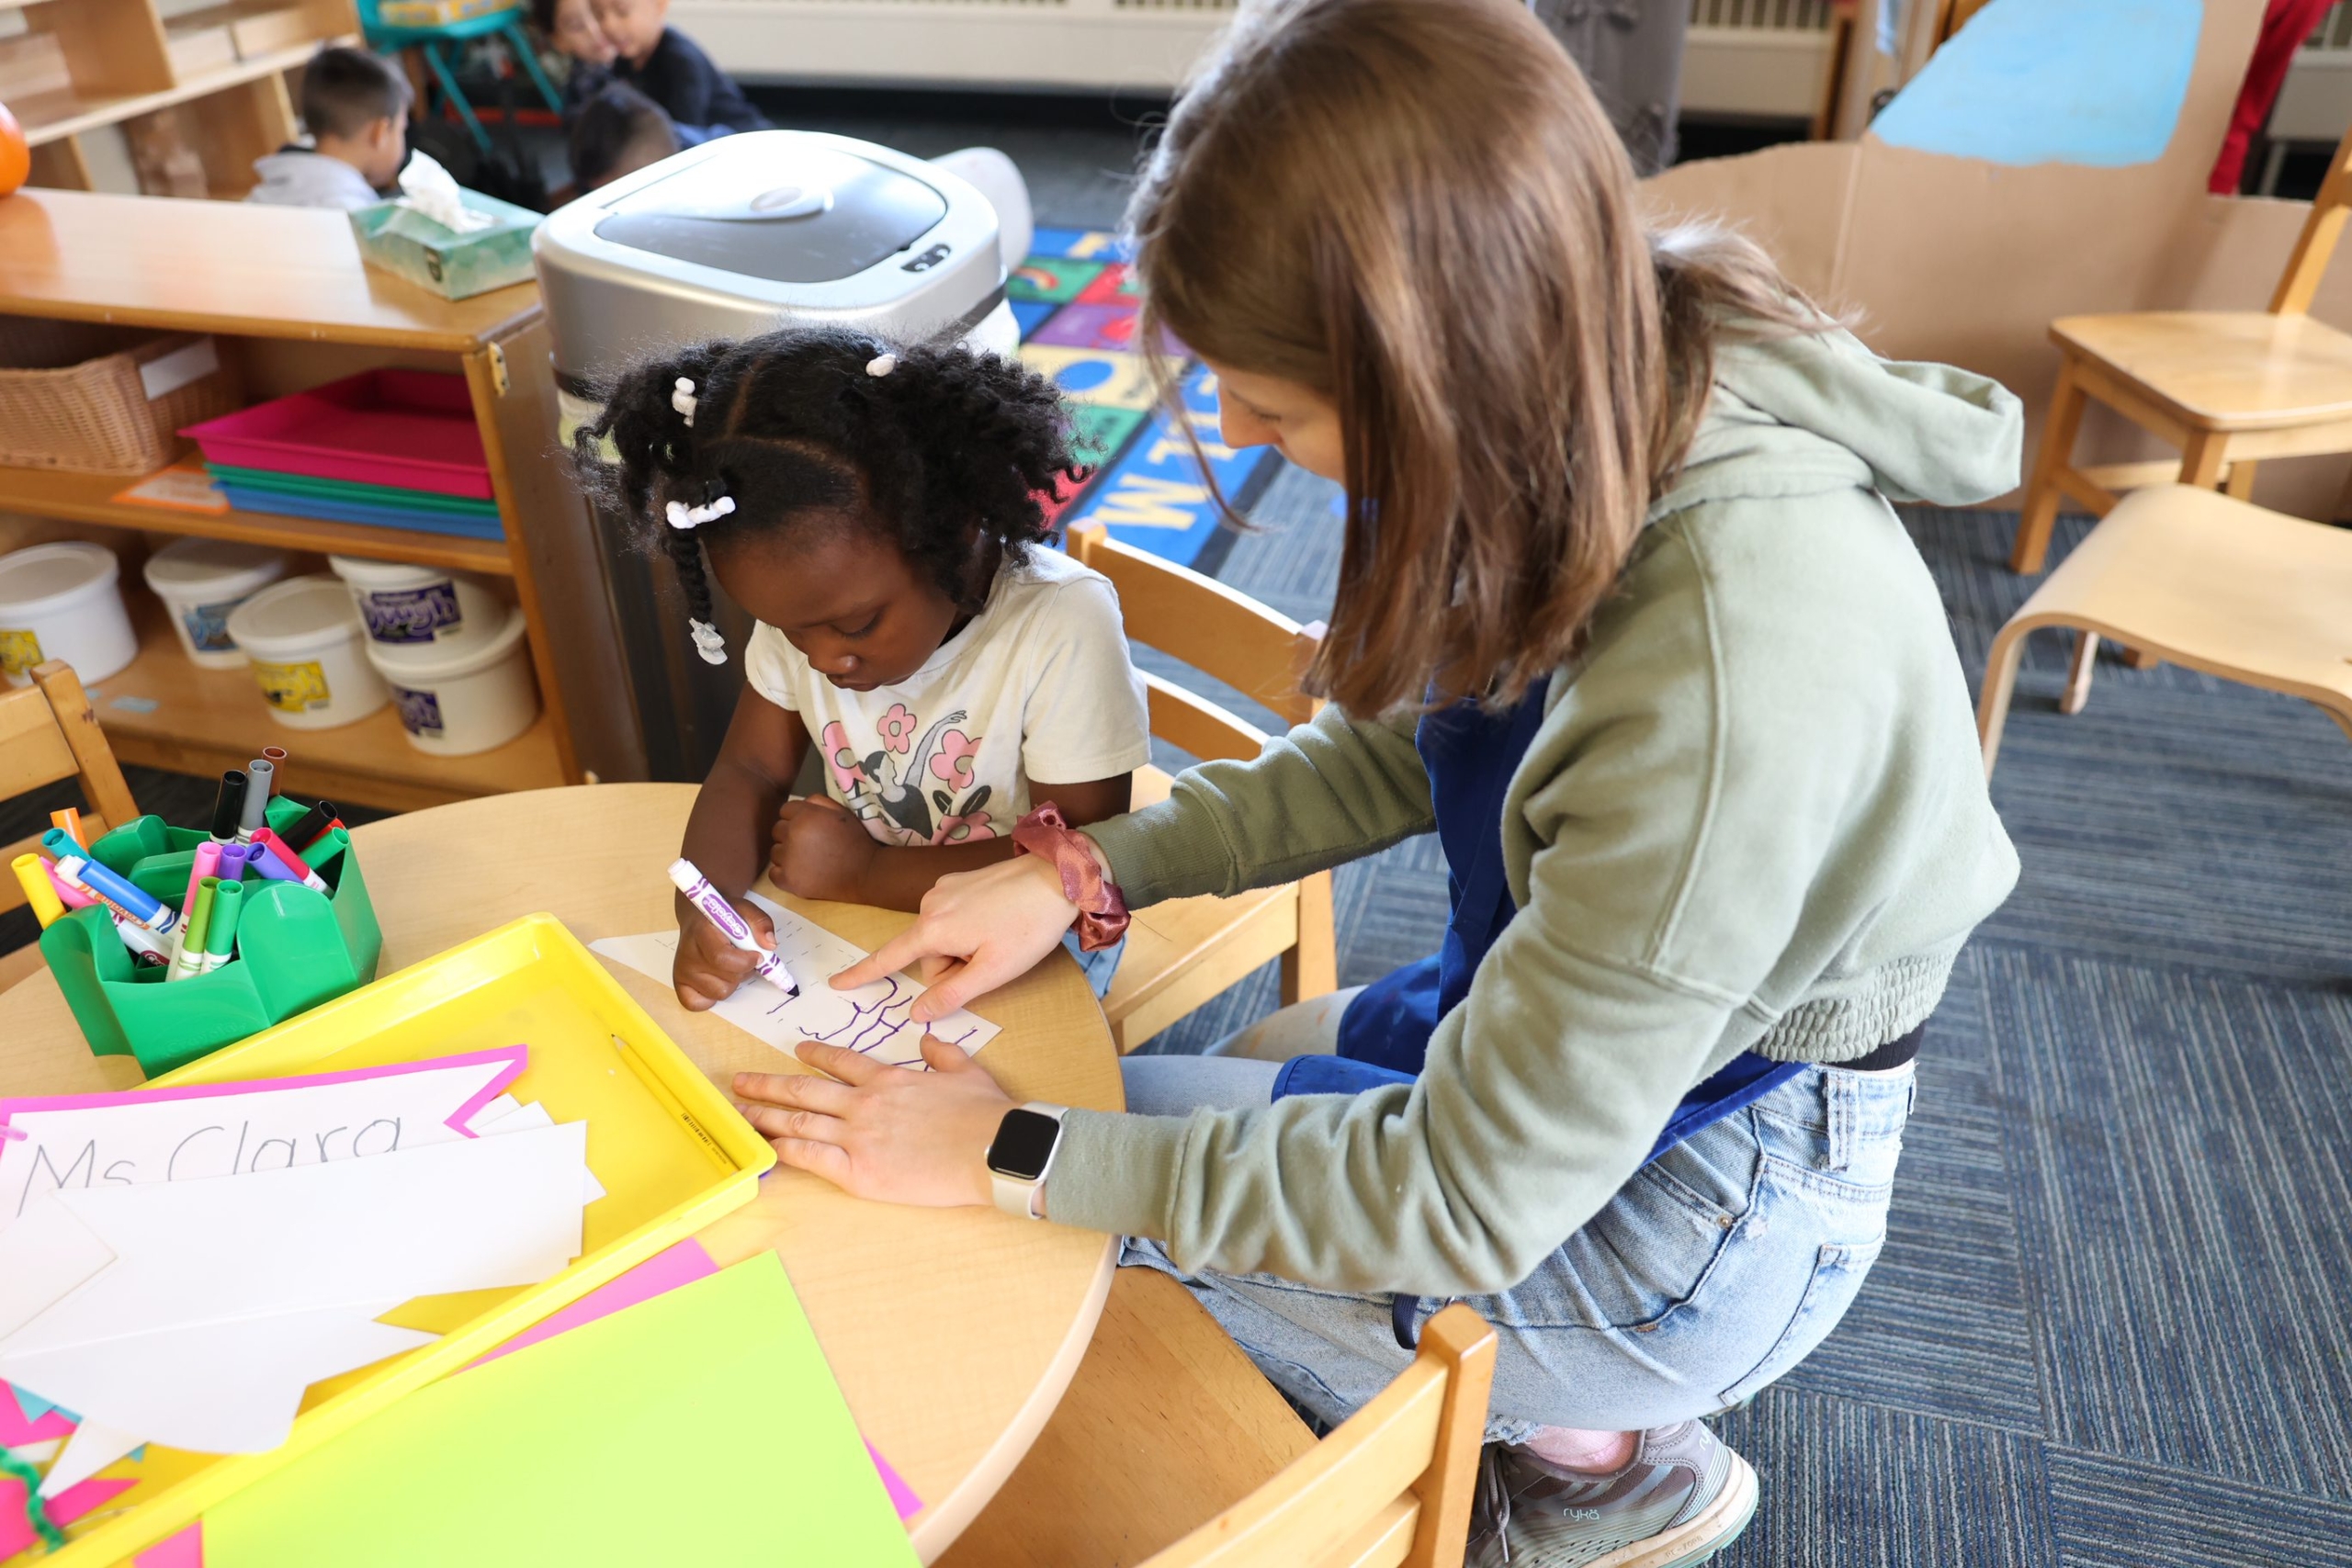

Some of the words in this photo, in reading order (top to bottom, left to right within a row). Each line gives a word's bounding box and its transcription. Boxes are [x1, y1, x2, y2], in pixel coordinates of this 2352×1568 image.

[707, 897, 745, 937] Crayola
[17, 1138, 136, 1219] Ms
[167, 1116, 401, 1182] Clara
[1563, 1508, 1600, 1522] rykä
